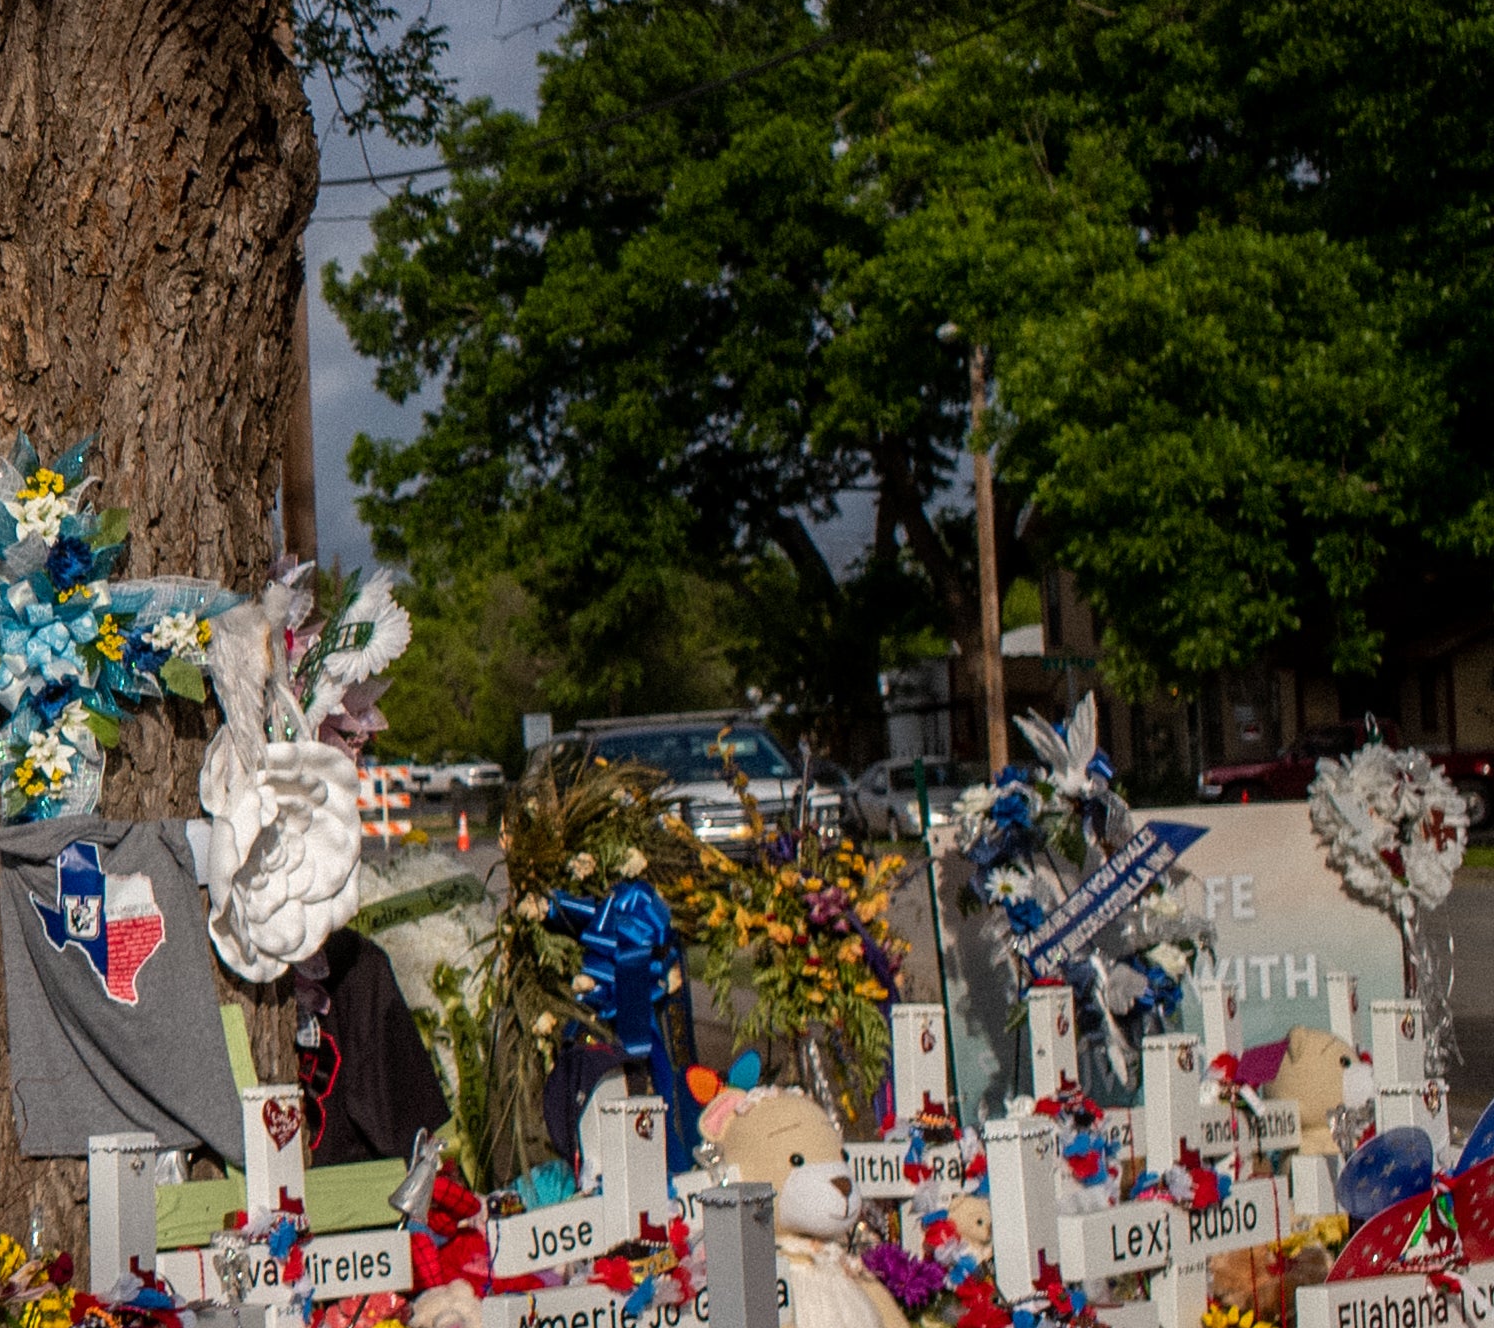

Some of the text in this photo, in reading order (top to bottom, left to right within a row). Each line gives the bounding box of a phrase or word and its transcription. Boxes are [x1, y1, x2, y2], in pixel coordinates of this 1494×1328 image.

[528, 1220, 593, 1261] Jose
[1188, 1198, 1258, 1245] Rubio
[304, 1251, 392, 1285] ireles
